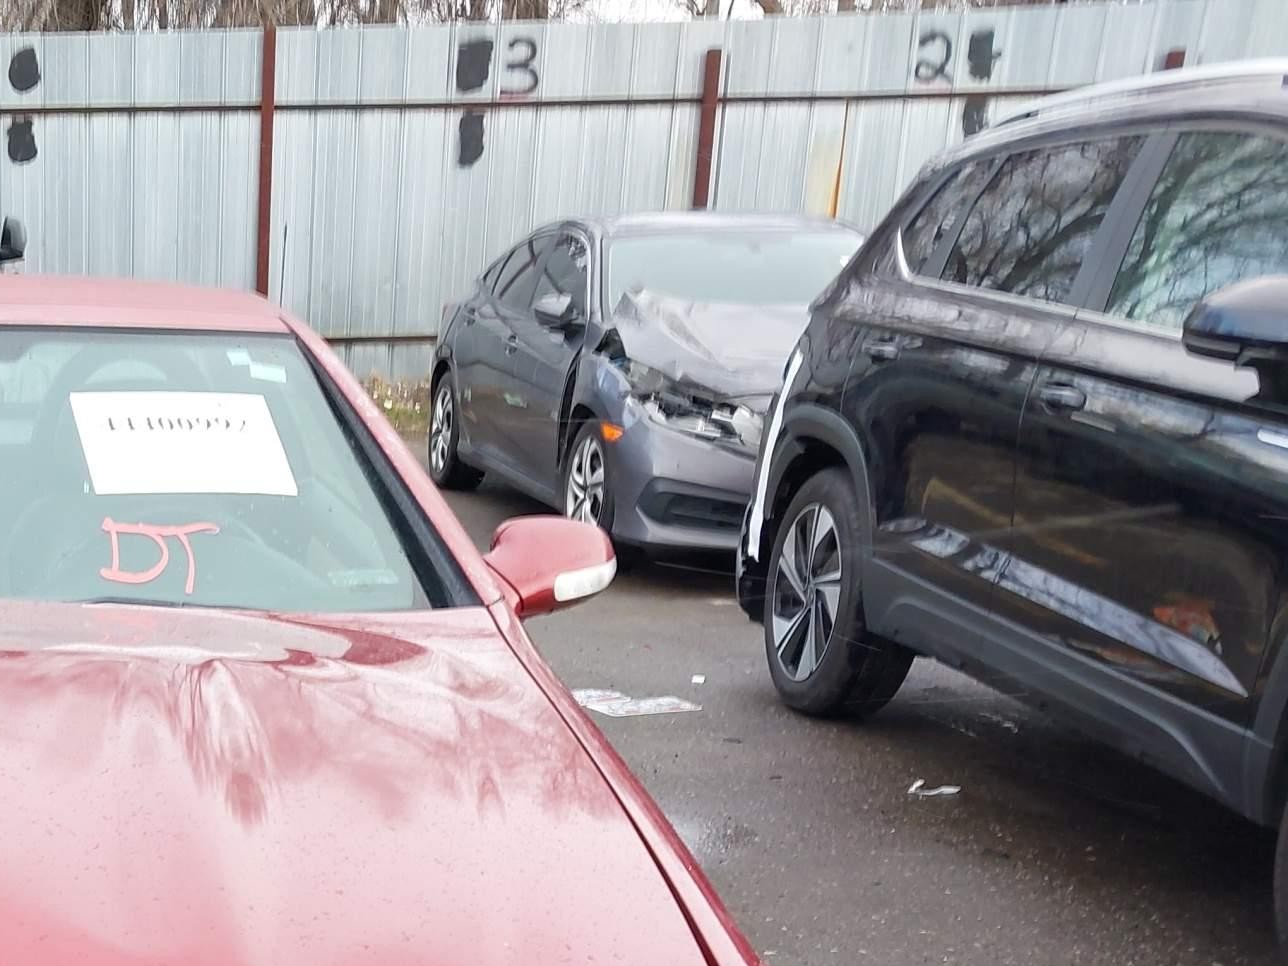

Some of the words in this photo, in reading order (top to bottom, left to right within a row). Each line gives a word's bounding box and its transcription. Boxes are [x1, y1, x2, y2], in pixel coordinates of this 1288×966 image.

[505, 39, 539, 95] 3
[915, 31, 953, 80] 2
[99, 517, 220, 594] DT
